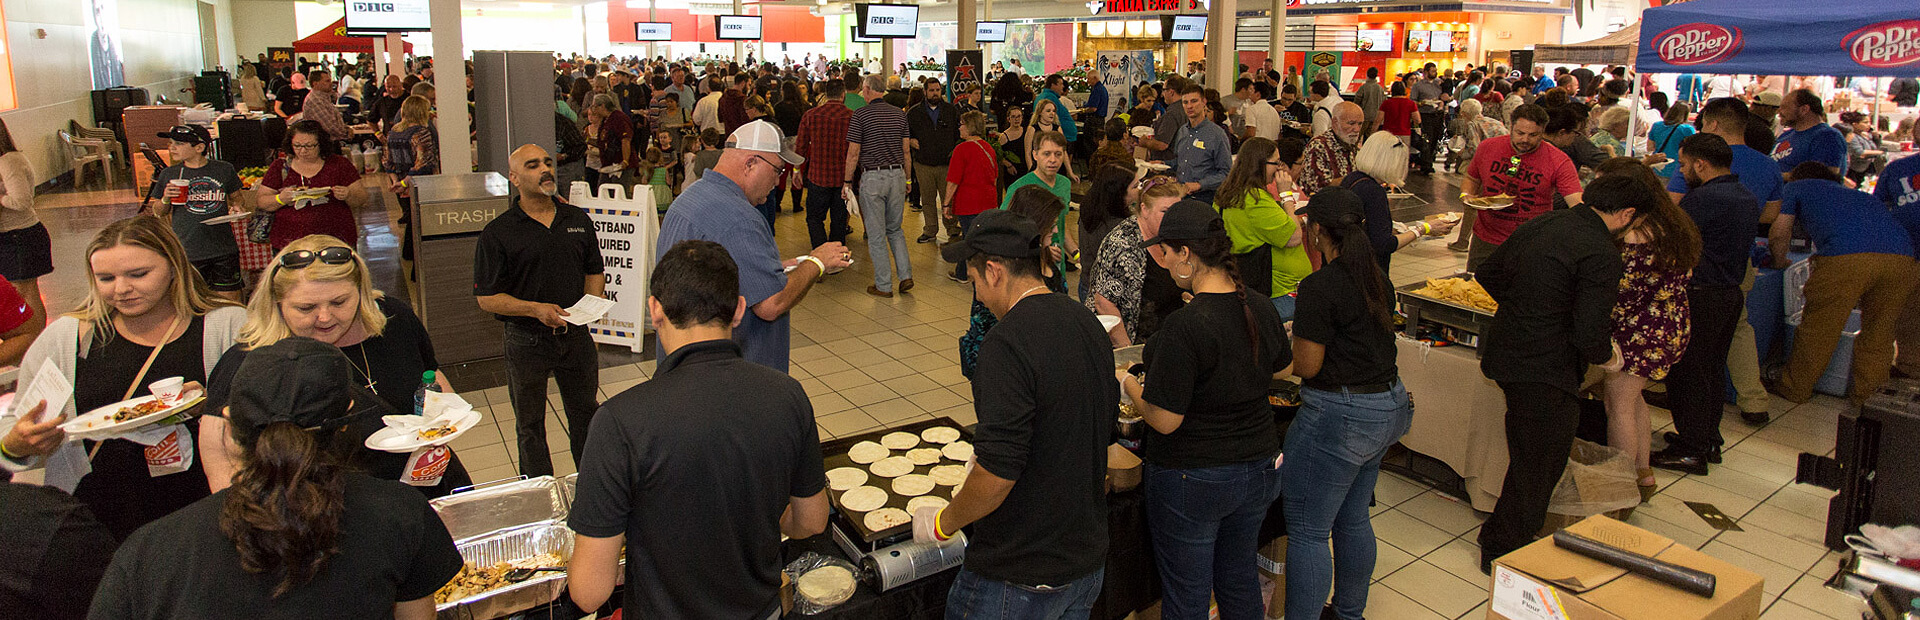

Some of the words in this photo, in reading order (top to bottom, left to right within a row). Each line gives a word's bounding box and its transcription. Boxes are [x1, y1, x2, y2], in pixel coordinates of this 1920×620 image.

[1107, 0, 1146, 13] ITALIA
[1147, 0, 1198, 11] EXPRES
[1686, 29, 1711, 46] Dr
[1886, 27, 1918, 46] Dr
[1660, 33, 1727, 60] Pepper
[1853, 31, 1920, 62] Peppe
[1491, 161, 1543, 185] DAEKS
[435, 209, 496, 225] TRASH
[600, 239, 631, 251] UIRED
